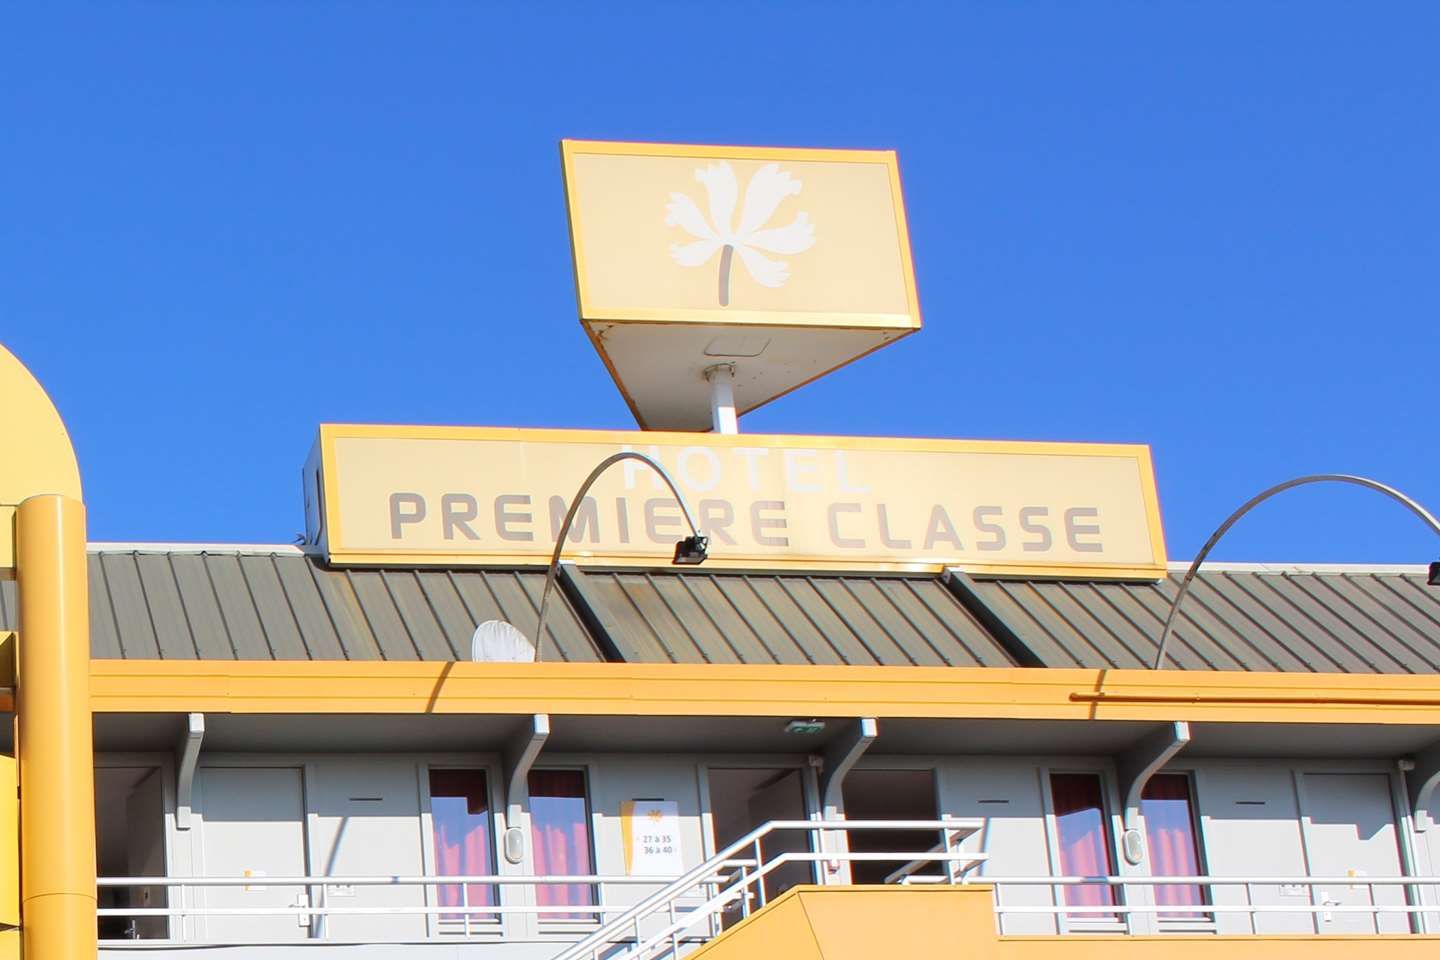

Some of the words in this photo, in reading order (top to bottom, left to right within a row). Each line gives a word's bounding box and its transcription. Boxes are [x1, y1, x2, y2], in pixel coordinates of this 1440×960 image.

[621, 444, 873, 494] HOTEL
[389, 492, 790, 548] PREMIERE
[826, 502, 1104, 553] CLASSE
